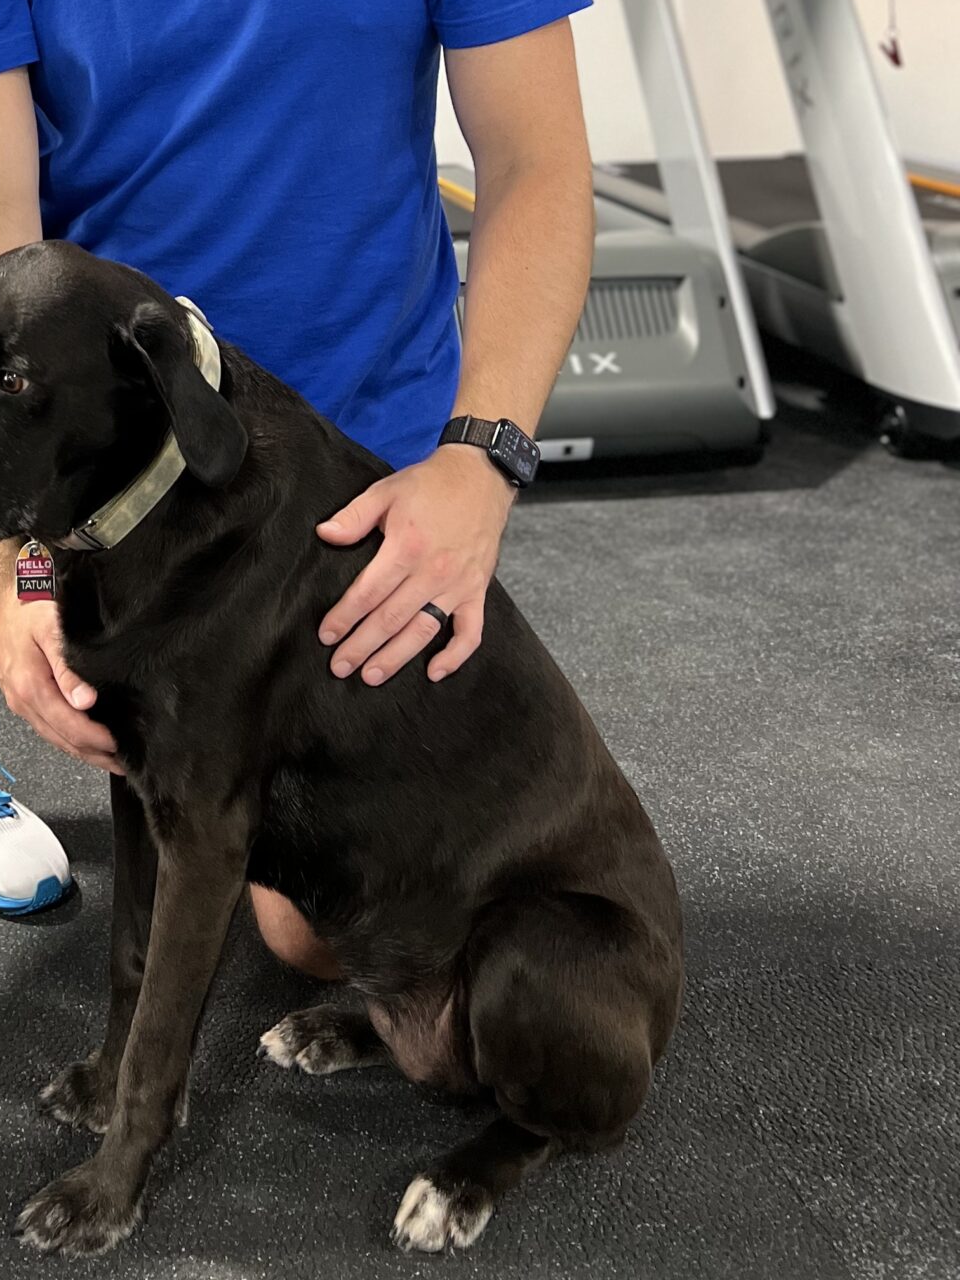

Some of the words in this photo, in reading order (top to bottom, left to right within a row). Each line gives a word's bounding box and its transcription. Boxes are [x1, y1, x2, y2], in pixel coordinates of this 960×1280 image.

[558, 351, 622, 376] IX
[18, 560, 52, 569] HELLO
[20, 580, 52, 590] TATUM
